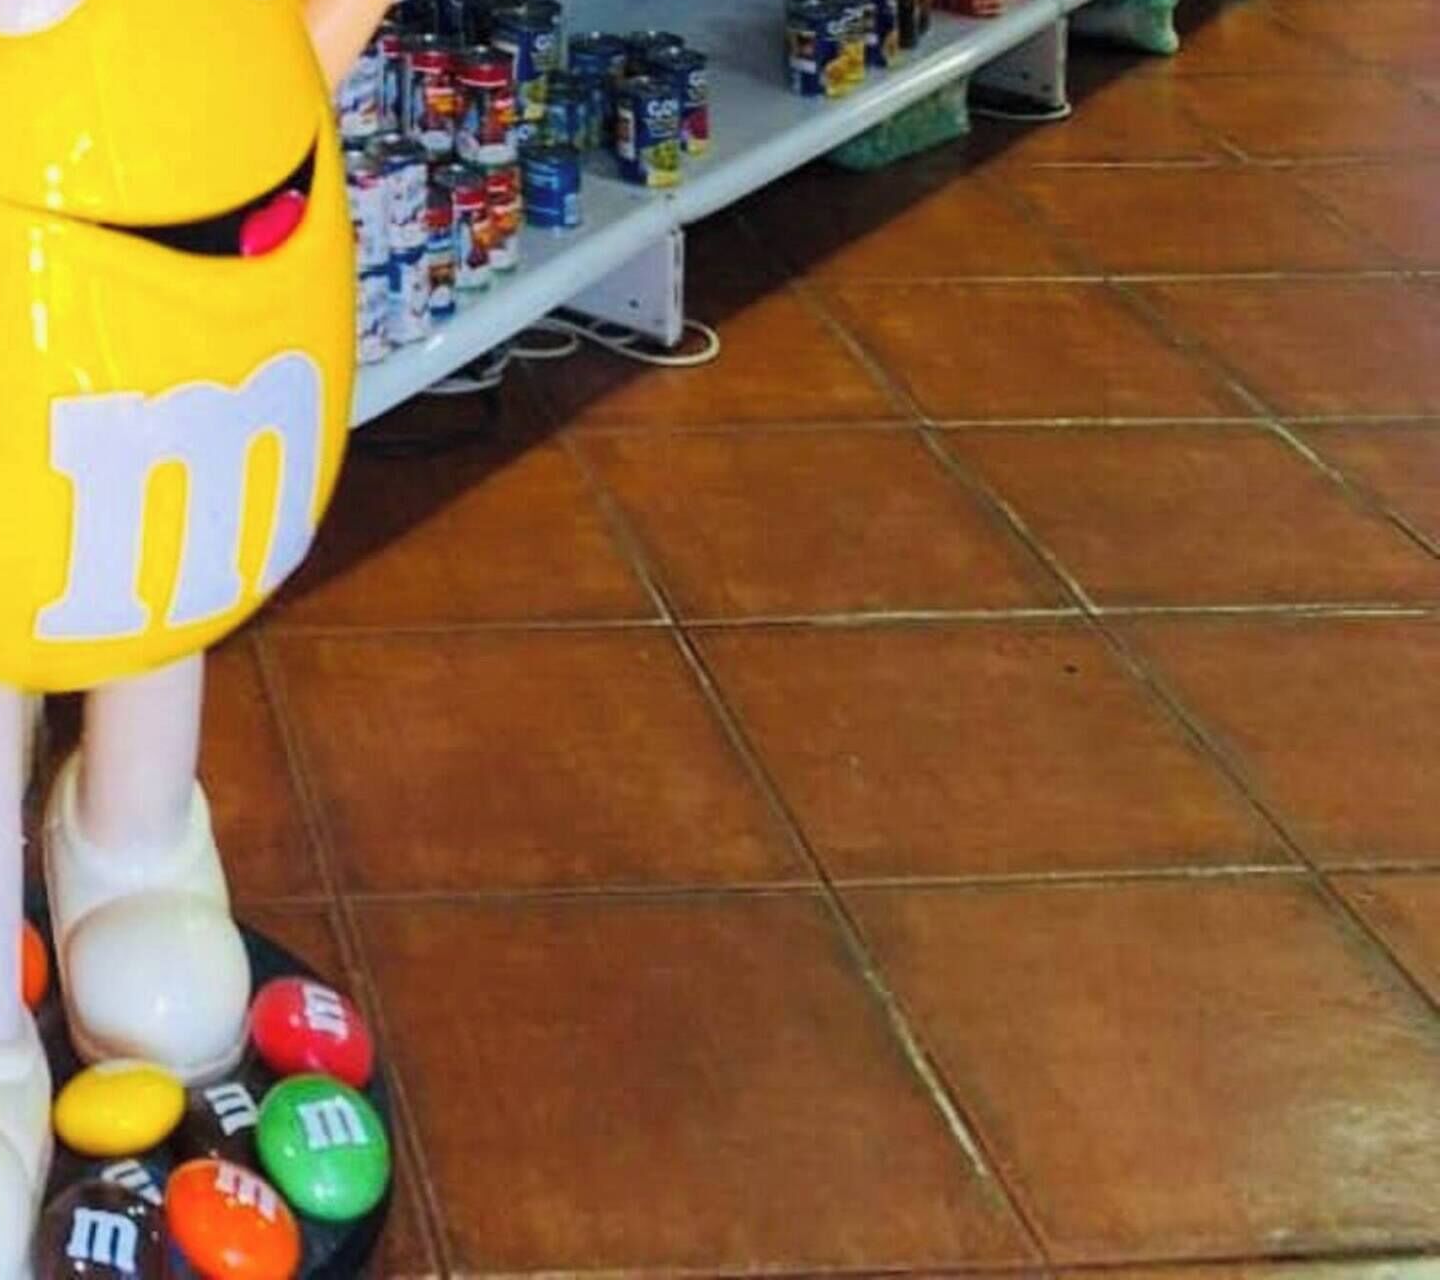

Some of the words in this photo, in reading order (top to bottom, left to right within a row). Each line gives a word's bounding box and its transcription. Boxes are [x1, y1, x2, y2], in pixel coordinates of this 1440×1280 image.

[34, 349, 323, 640] m
[297, 1095, 369, 1151] m
[65, 1205, 139, 1274] m
